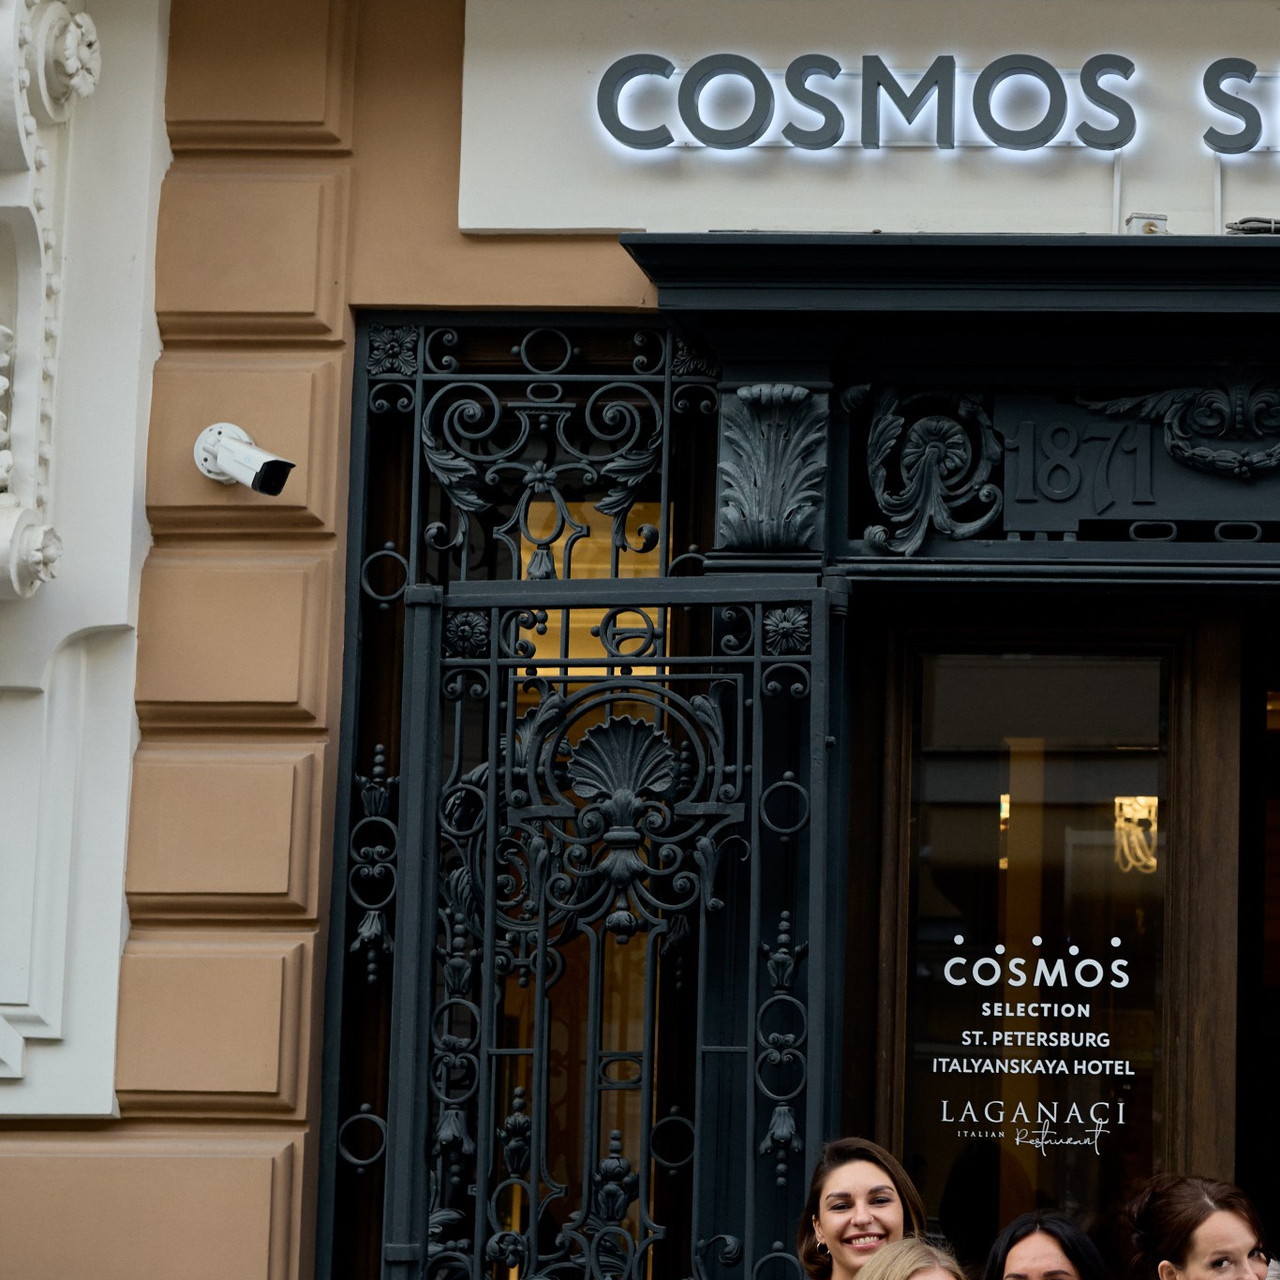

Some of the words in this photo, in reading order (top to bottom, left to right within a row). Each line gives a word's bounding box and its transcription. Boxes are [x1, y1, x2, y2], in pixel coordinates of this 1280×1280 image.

[596, 53, 1137, 152] COSMOS
[1004, 419, 1156, 515] 1871
[943, 956, 1130, 989] COSMOS
[981, 1002, 1091, 1018] SELECTION
[961, 1030, 988, 1046] ST.
[992, 1031, 1111, 1048] PETERSBURG
[932, 1058, 1069, 1075] ITALYANSKAYA
[1073, 1060, 1136, 1076] HOTEL
[940, 1100, 1126, 1125] LAGANACI
[957, 1130, 1006, 1138] ITALIAN
[1014, 1117, 1111, 1157] Restaurant
